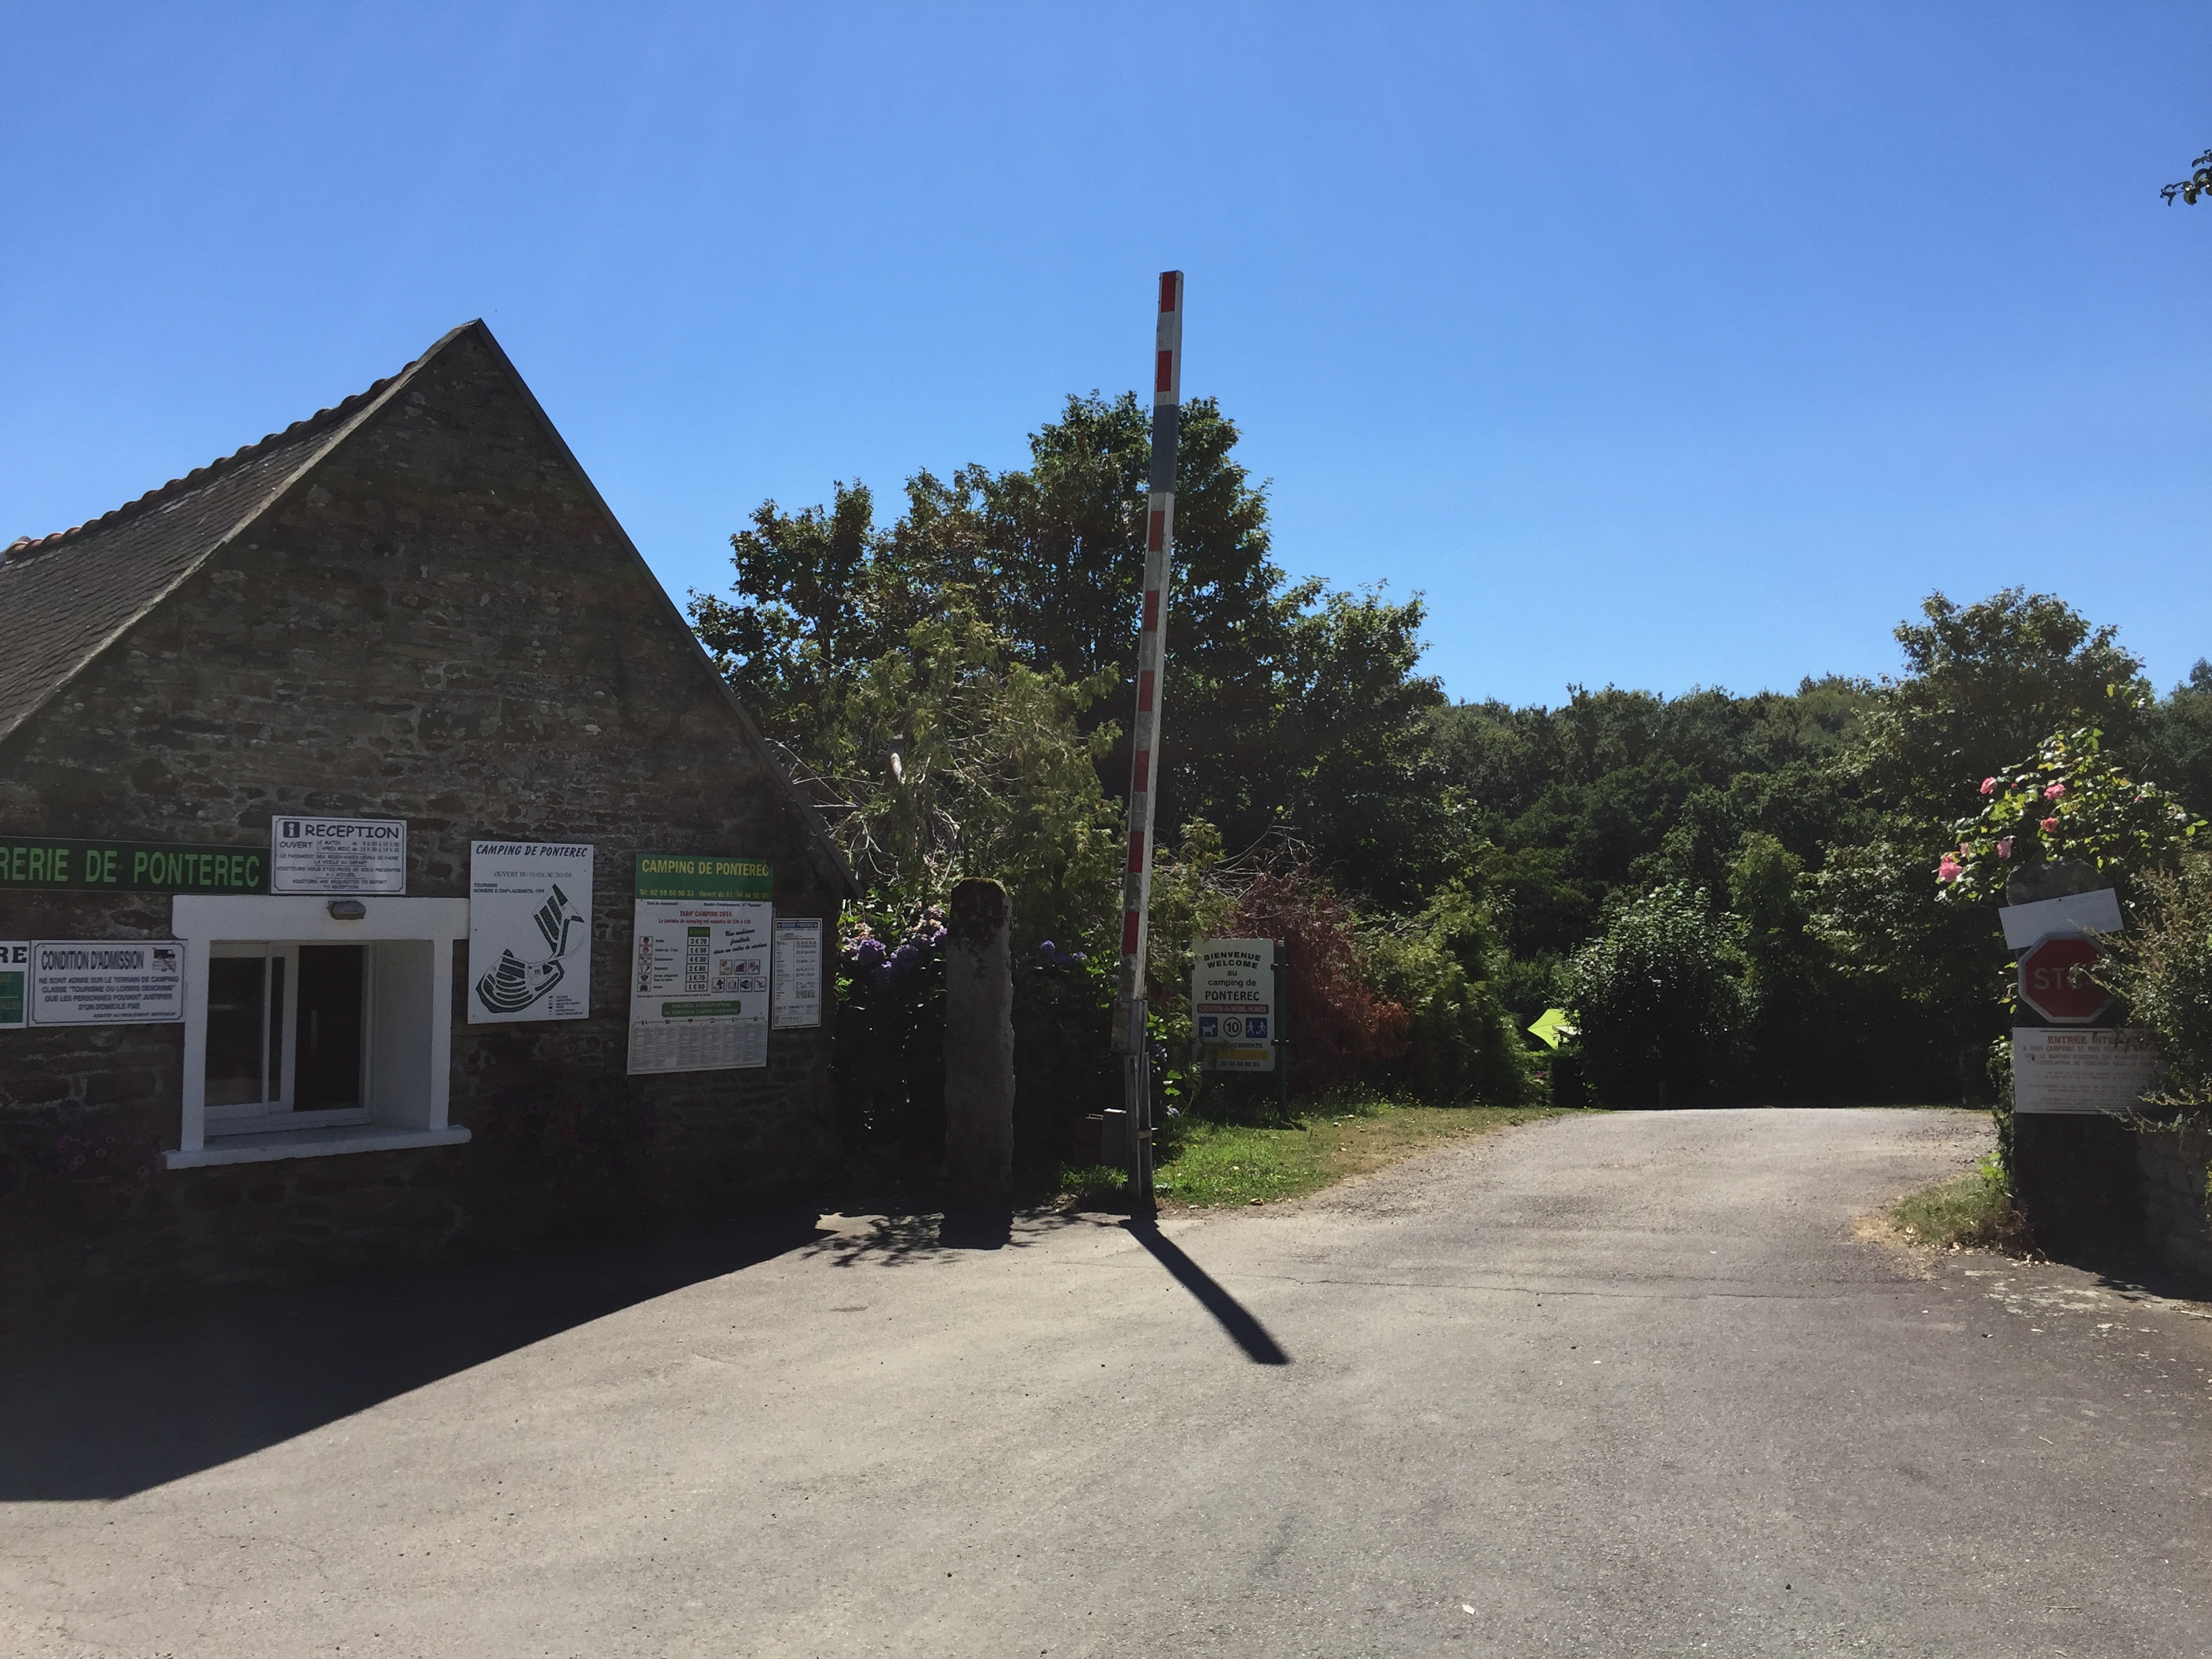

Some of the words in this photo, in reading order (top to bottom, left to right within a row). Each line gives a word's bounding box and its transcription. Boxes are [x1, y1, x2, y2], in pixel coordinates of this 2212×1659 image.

[305, 824, 399, 839] RECEPTION
[279, 840, 313, 848] OUVERT
[476, 844, 521, 856] CAMPING
[524, 846, 537, 857] DE
[539, 846, 588, 858] PONTEREC
[86, 850, 118, 883] DE
[134, 851, 260, 887] PONTEREC
[642, 859, 695, 874] CAMPING
[699, 861, 713, 875] DE
[716, 862, 769, 877] PONTEREC
[41, 950, 89, 970] CONDITION
[90, 950, 144, 970] D'ADMISSION
[1204, 951, 1261, 962] BIENVENUE
[1206, 960, 1259, 969] WELCOME
[1208, 979, 1244, 988] camping
[1205, 991, 1260, 1002] PONTEREC
[1226, 1021, 1240, 1033] 10
[2048, 1036, 2087, 1044] ENTREE
